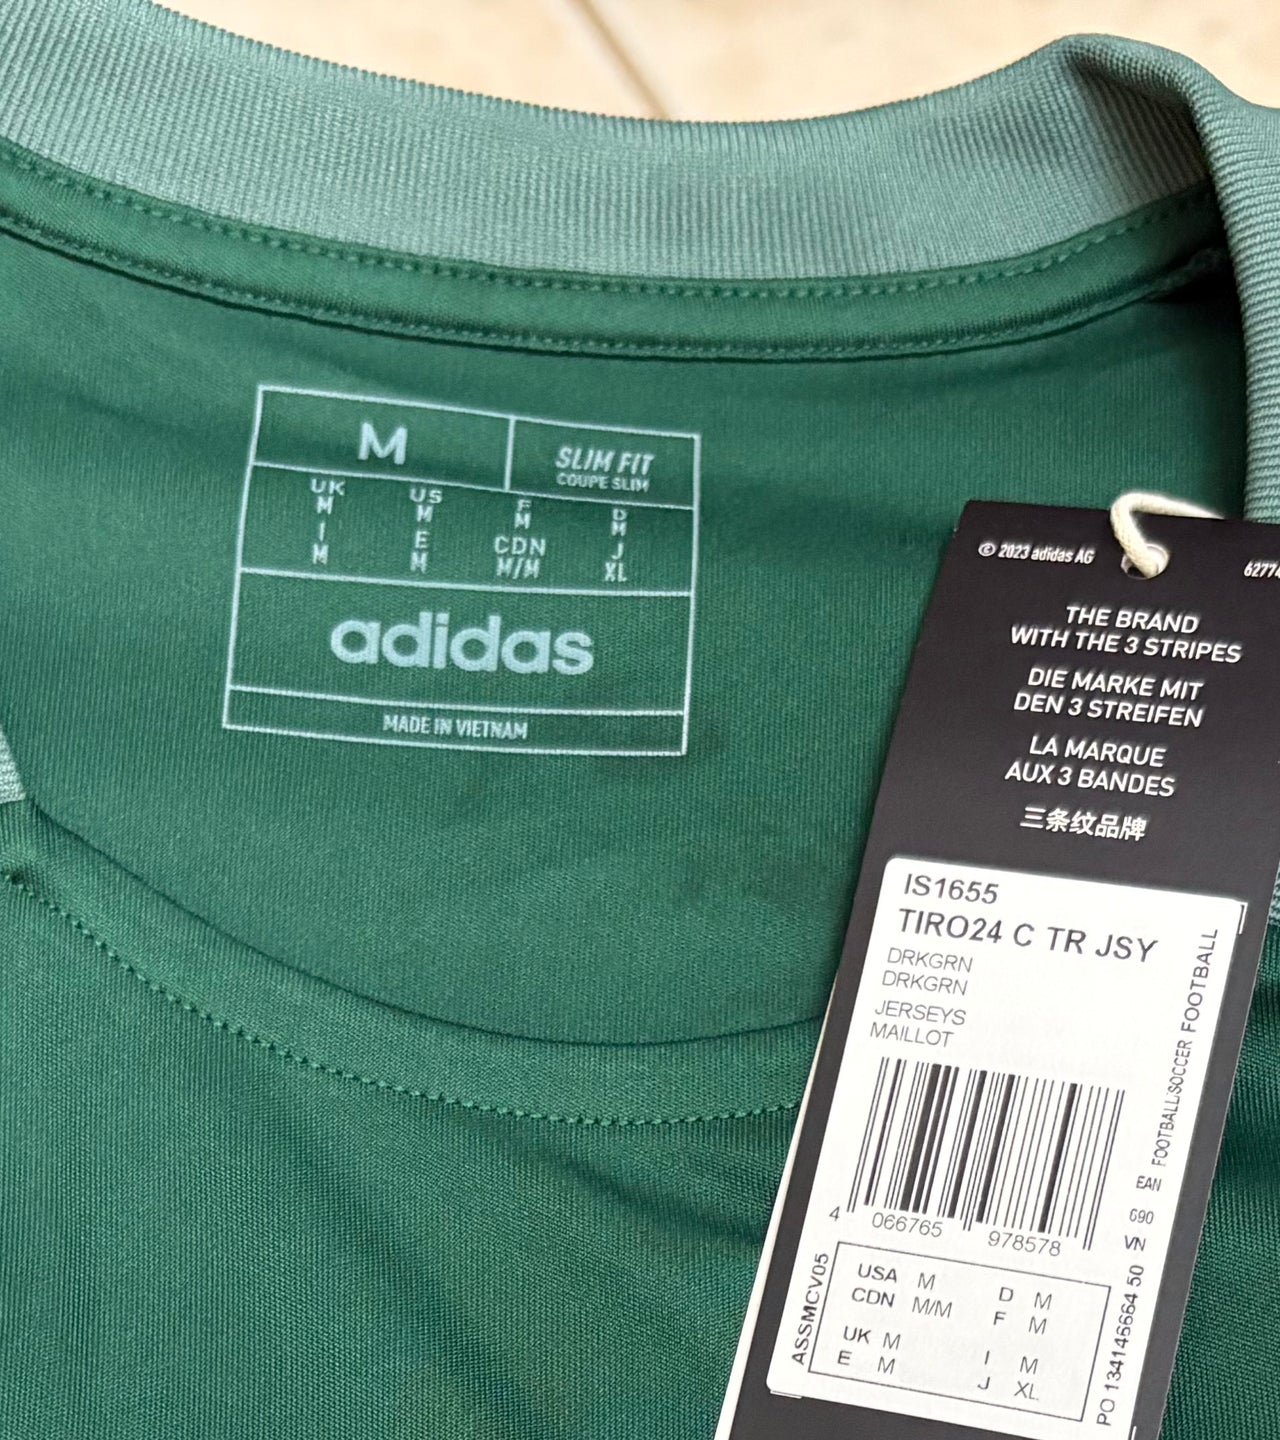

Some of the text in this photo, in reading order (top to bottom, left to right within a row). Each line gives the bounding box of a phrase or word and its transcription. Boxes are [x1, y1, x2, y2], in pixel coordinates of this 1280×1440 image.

[357, 422, 408, 465] M
[555, 446, 654, 475] SLIM FIT
[310, 478, 345, 496] UK
[410, 488, 442, 504] US
[613, 508, 627, 521] D
[556, 472, 649, 492] COUPE SLIM
[317, 497, 627, 536] M M M M
[313, 543, 628, 582] M M M/M XL
[415, 531, 430, 549] E
[494, 535, 546, 557] CDN
[612, 543, 624, 560] J
[998, 543, 1030, 561] 2023
[1031, 546, 1074, 563] adidas
[1074, 548, 1096, 565] AG
[1067, 605, 1201, 634] THE BRAND
[330, 611, 595, 676] adidas
[1011, 626, 1243, 664] WITH THE 3 STRIPES
[1027, 667, 1204, 701] DIE MARKE MIT
[382, 714, 529, 740] MADE IN VIETNAM
[1013, 692, 1204, 728] DEN 3 STREIFEN
[1029, 734, 1167, 768] LA MARQUE
[1004, 760, 1176, 797] AUX 3 BANDES
[1020, 806, 1147, 842] 三条纹品牌
[904, 873, 999, 905] IS1655
[898, 908, 1158, 964] TIRO24 C TR JSY
[887, 947, 973, 974] DRKGRN
[881, 969, 969, 996] DRKGRN
[1180, 928, 1218, 1033] FOOTBALL
[874, 999, 967, 1027] JERSEYS
[869, 1021, 955, 1048] MAILLOT
[1136, 1175, 1162, 1192] EAN
[829, 1205, 1062, 1257] 4 066765 978578
[1124, 1234, 1146, 1252] VN
[857, 1263, 1053, 1311] USA M D M
[791, 1253, 829, 1366] ASSMCV05
[851, 1287, 1048, 1335] CDN M/M F M
[843, 1325, 872, 1345] UK
[883, 1332, 901, 1351] M
[1020, 1356, 1039, 1375] M
[1096, 1265, 1144, 1426] PO 134146664 50
[837, 1350, 1037, 1401] E M J XL
